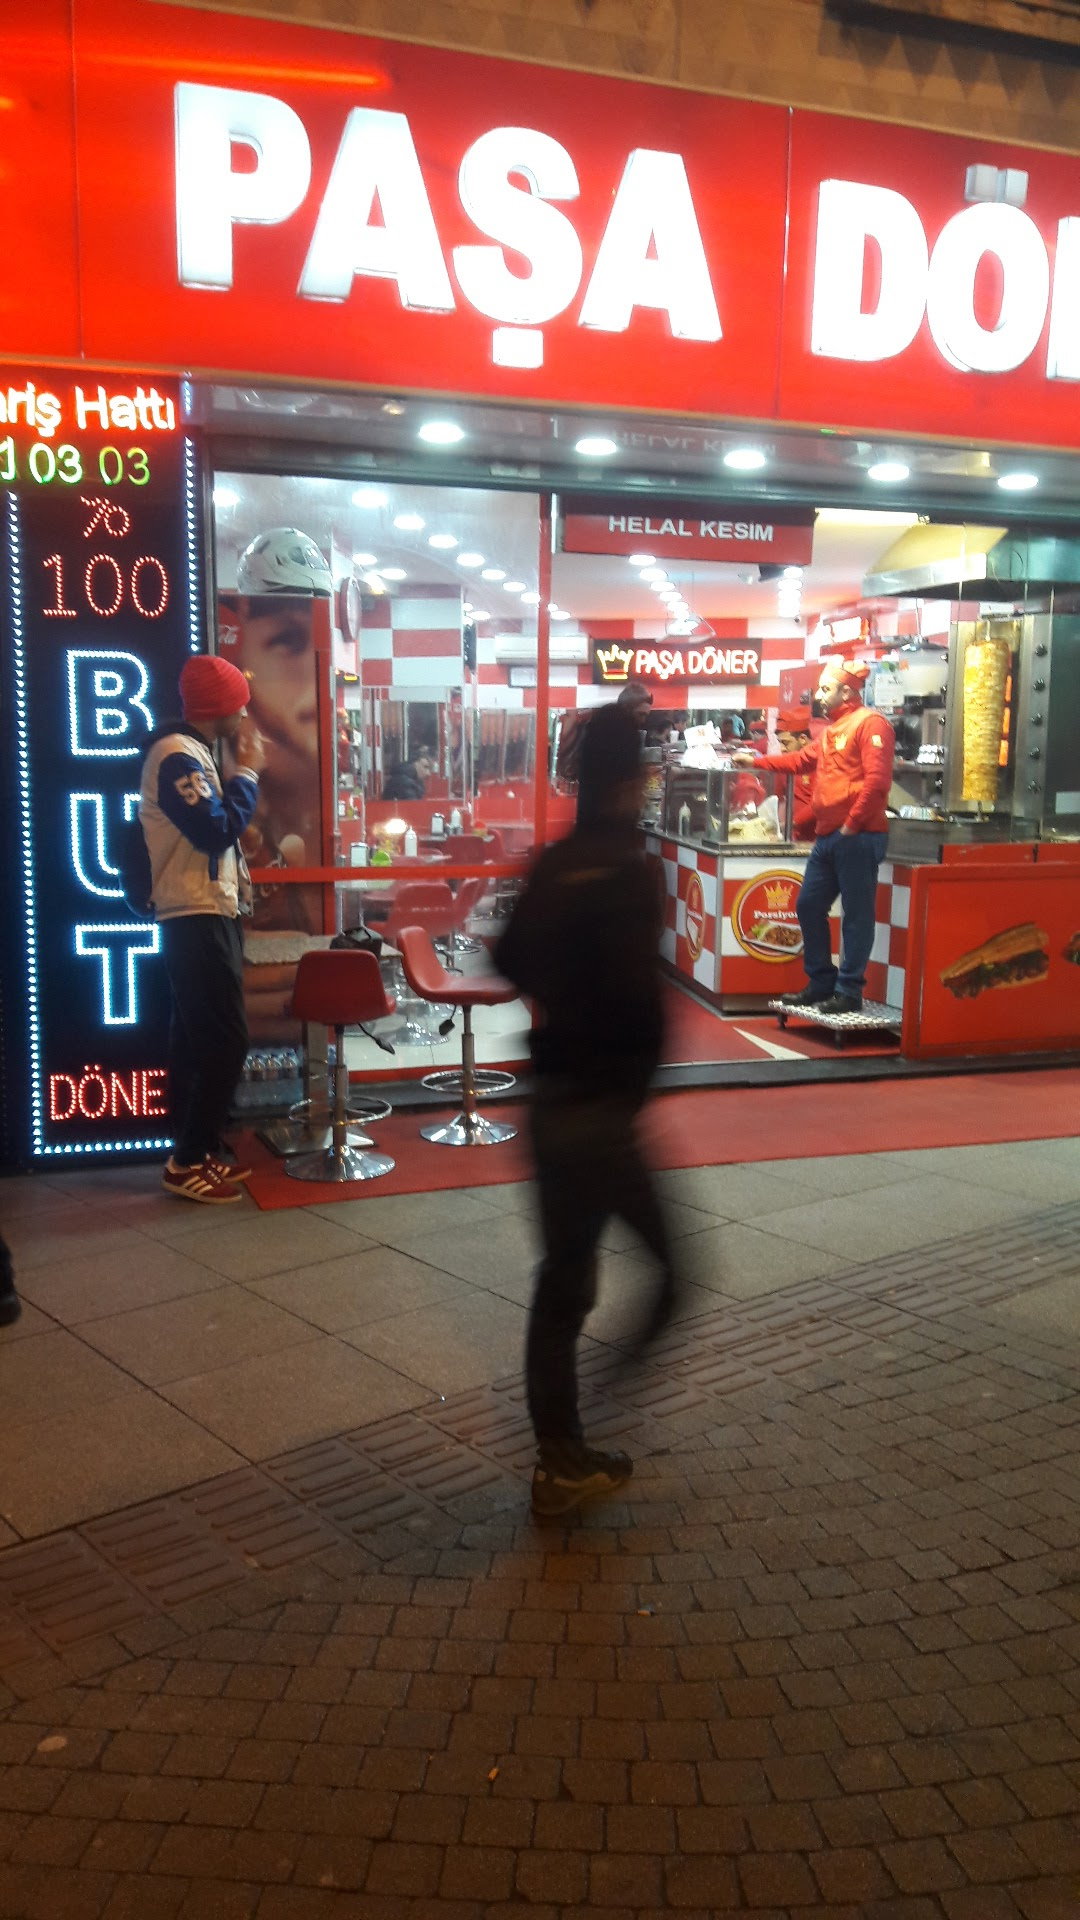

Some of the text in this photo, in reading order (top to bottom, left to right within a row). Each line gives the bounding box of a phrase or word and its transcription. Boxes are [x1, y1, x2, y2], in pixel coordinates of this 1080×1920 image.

[175, 81, 723, 370] PAŞA
[75, 385, 175, 431] Hattı
[29, 442, 83, 484] 03
[99, 446, 150, 486] 03
[608, 515, 693, 537] HELAL
[43, 553, 169, 617] 100
[635, 646, 759, 680] PAŞA DÖNER
[49, 1064, 168, 1121] DÖNE
